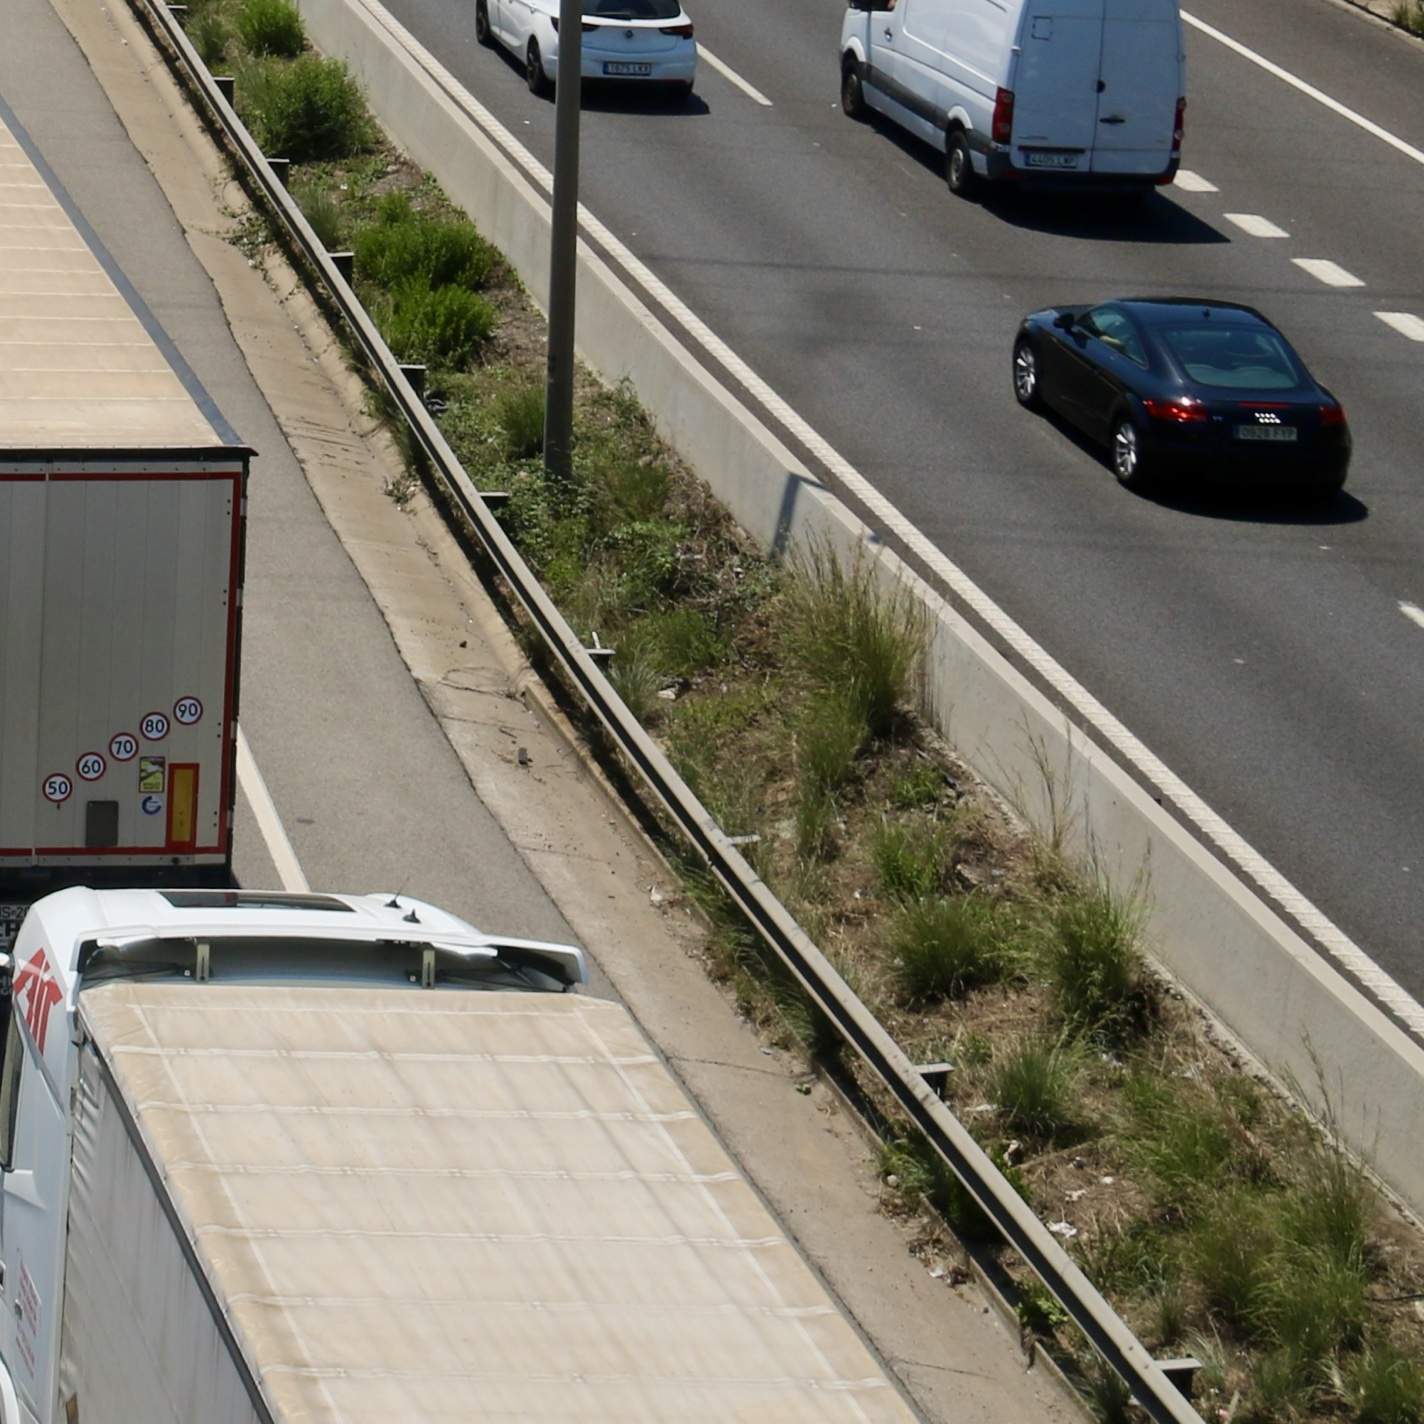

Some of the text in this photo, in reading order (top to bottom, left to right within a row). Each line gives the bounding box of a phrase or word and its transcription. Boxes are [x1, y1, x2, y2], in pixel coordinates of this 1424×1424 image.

[178, 702, 198, 718] 90
[145, 718, 165, 734] 80
[114, 739, 134, 755] 70
[81, 759, 101, 774] 60
[48, 781, 68, 796] 50
